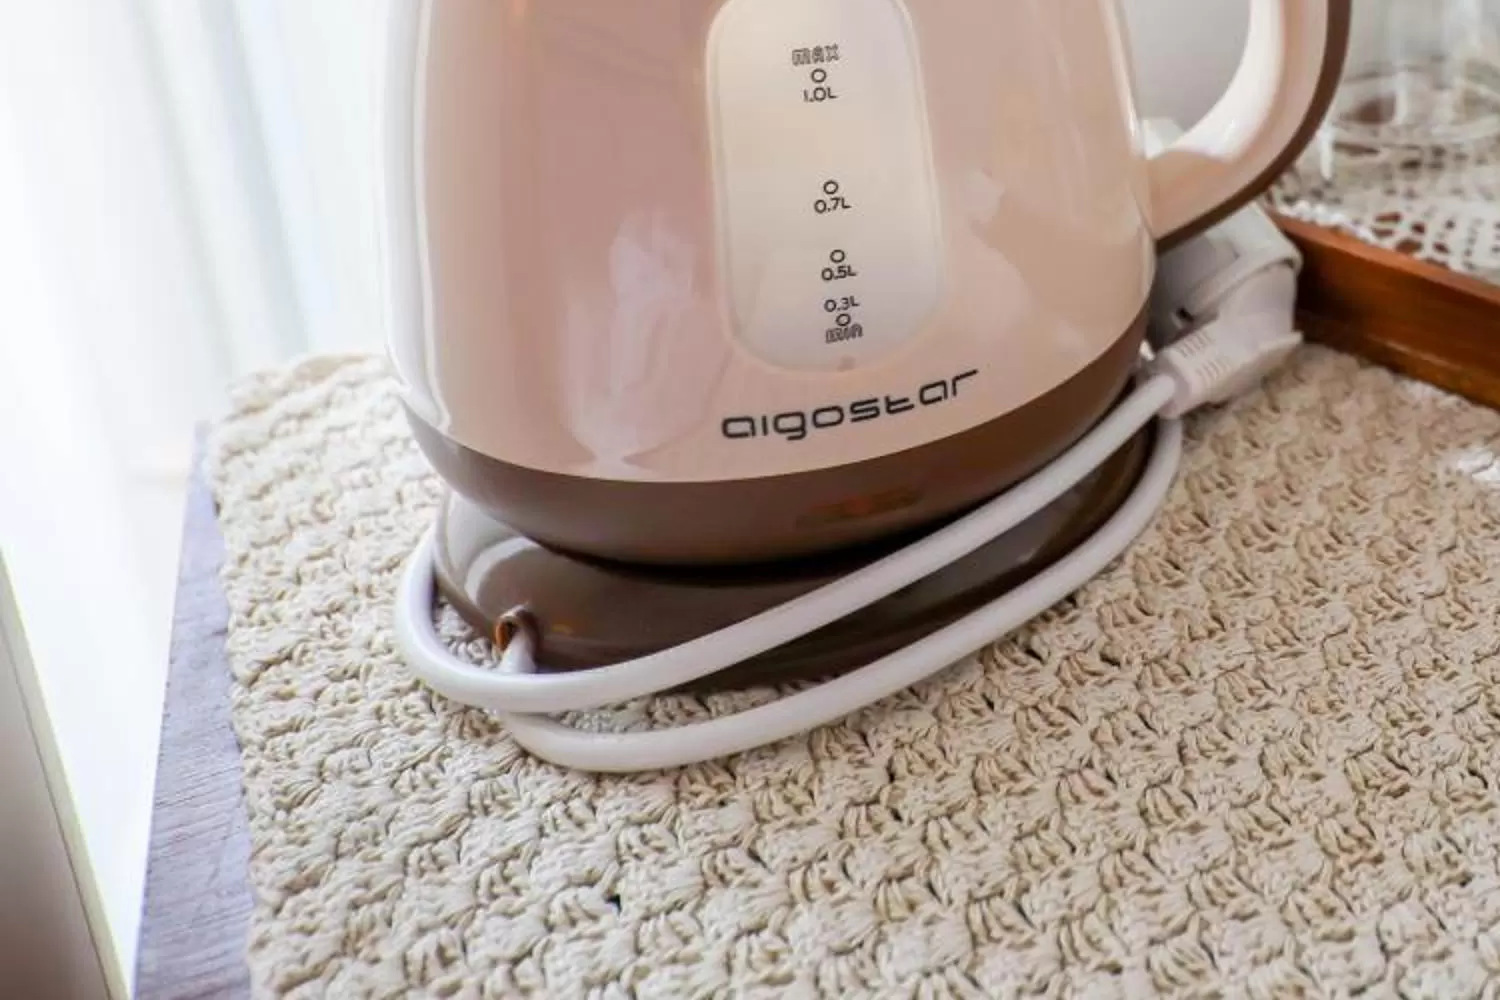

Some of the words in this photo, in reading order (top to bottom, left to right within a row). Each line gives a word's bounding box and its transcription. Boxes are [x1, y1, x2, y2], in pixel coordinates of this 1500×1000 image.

[803, 87, 838, 102] 1.0L
[814, 197, 852, 214] 0.7L
[821, 265, 857, 281] 0.5L
[823, 296, 859, 312] 0.3L
[721, 370, 979, 441] aigostar
